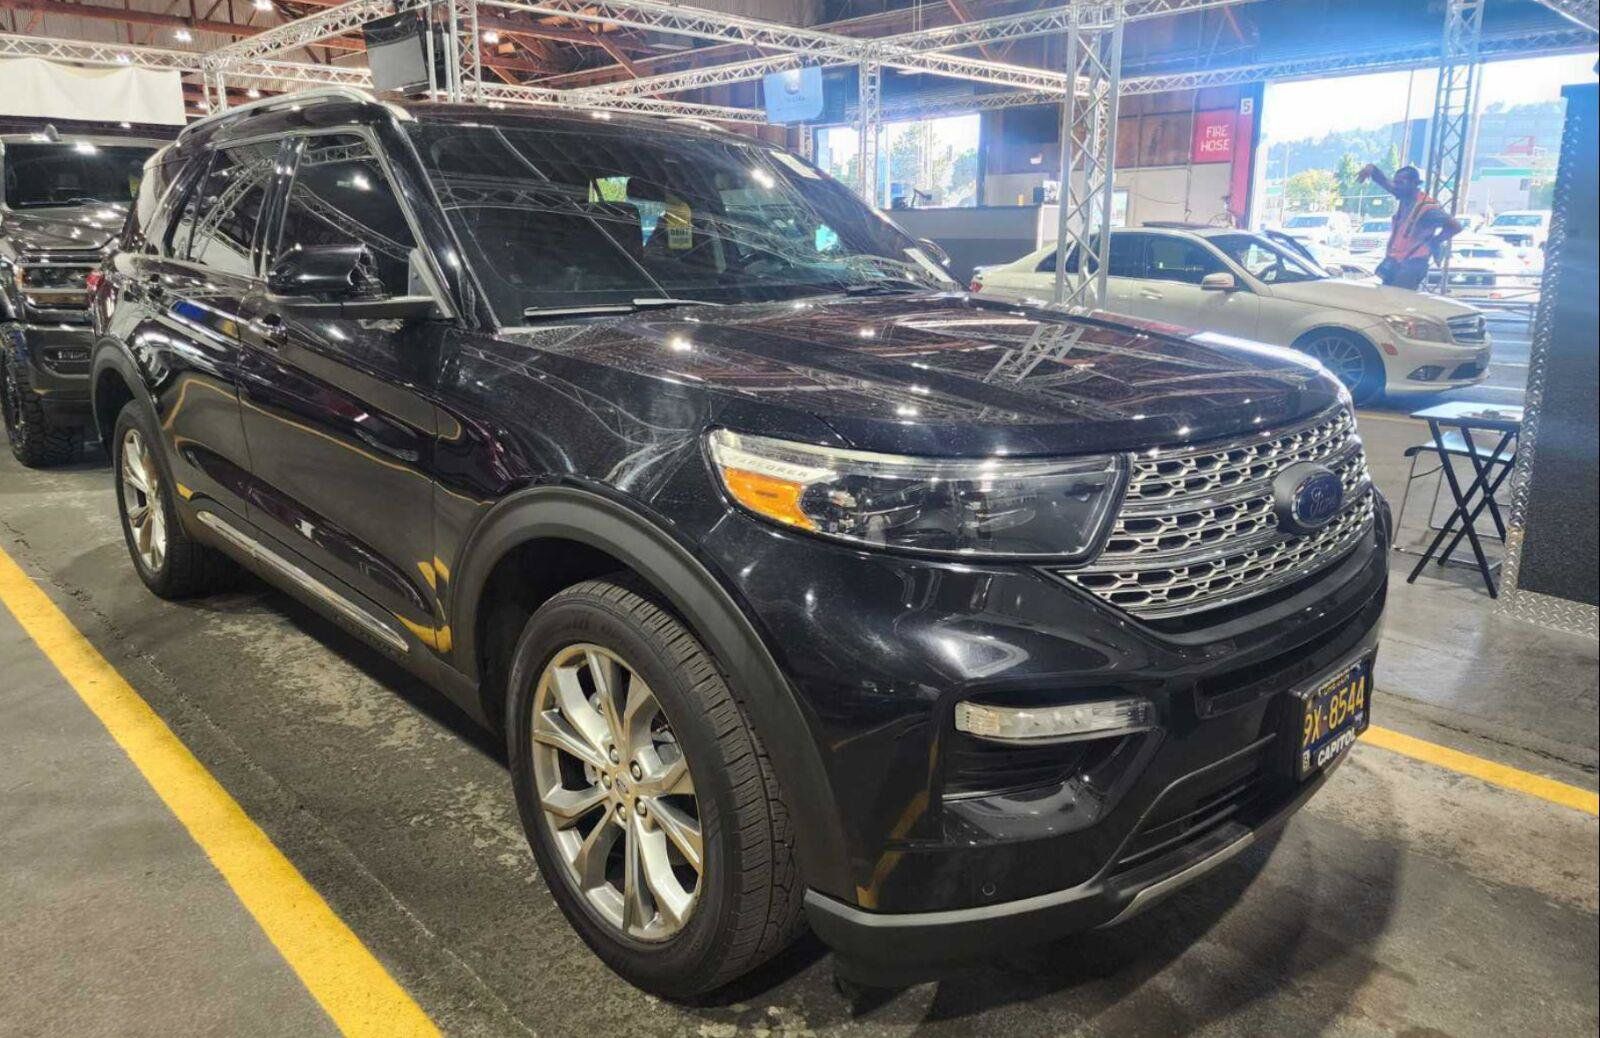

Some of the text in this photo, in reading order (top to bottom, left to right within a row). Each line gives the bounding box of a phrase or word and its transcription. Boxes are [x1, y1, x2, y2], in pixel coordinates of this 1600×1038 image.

[1206, 124, 1230, 138] FIRE
[1200, 138, 1231, 153] HOSE
[1317, 727, 1356, 767] CAPITOL
